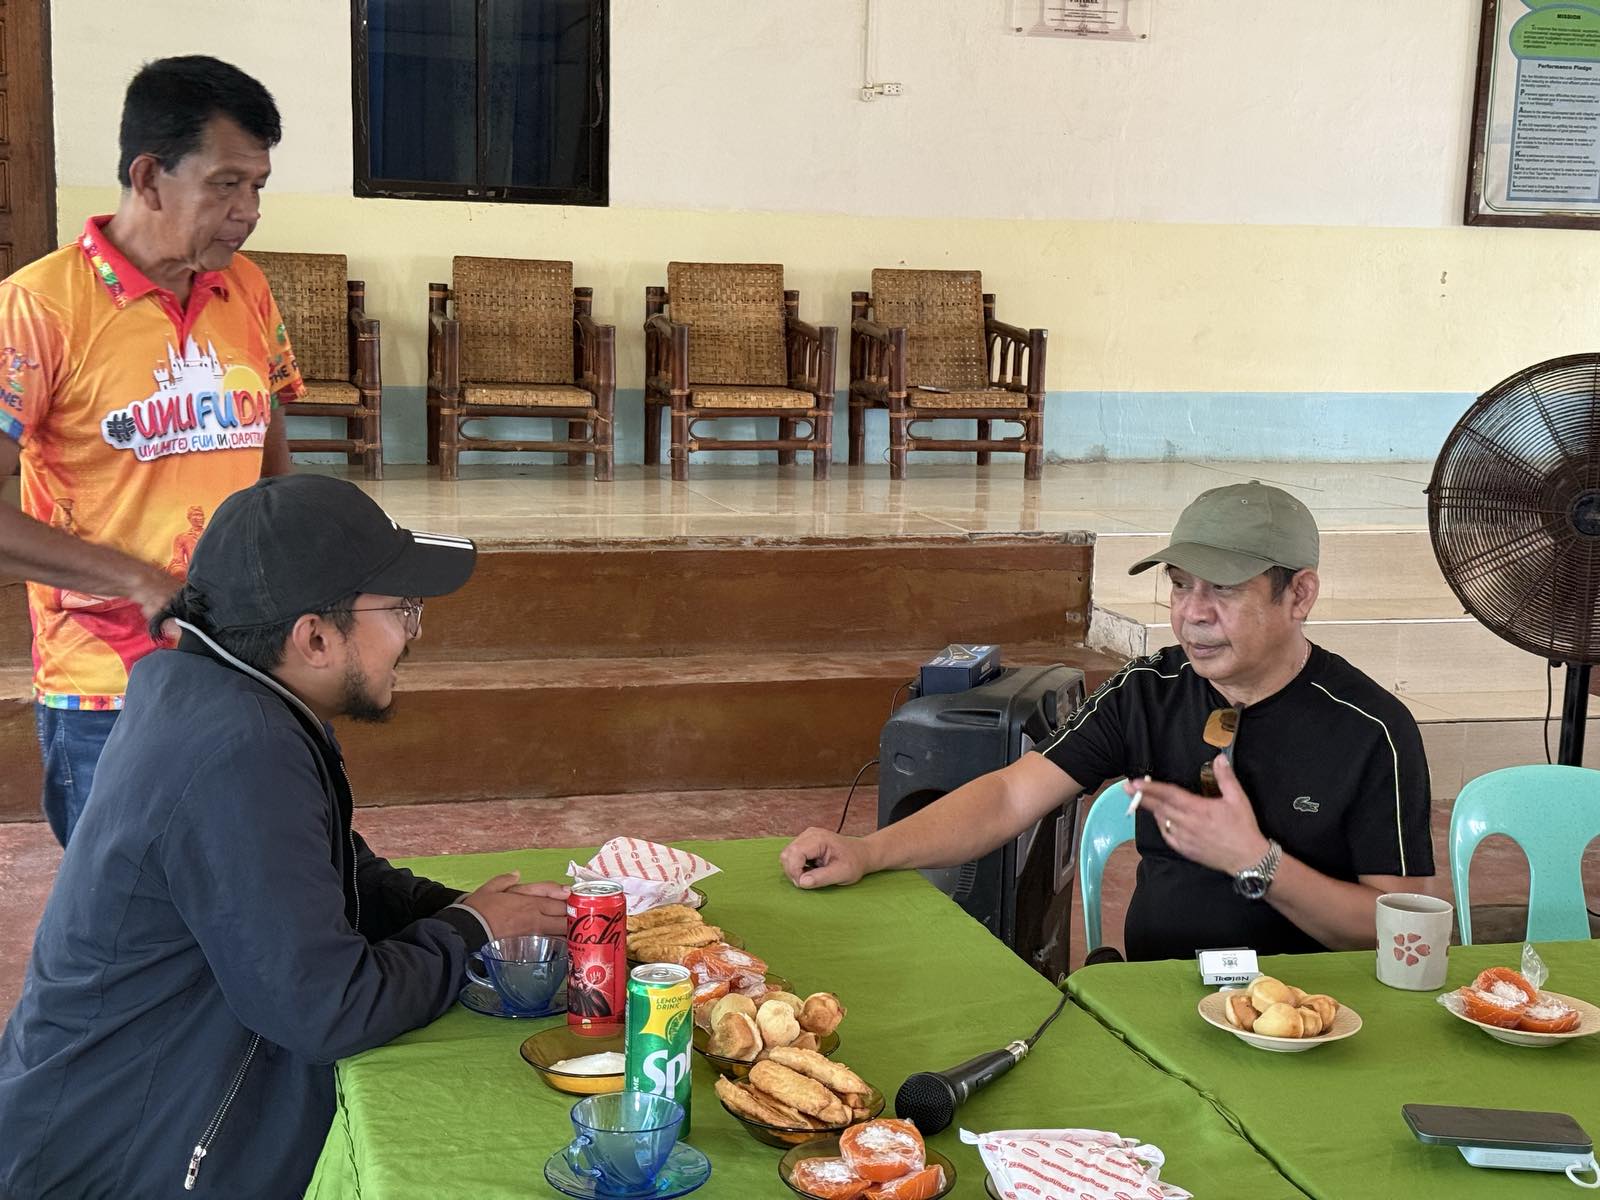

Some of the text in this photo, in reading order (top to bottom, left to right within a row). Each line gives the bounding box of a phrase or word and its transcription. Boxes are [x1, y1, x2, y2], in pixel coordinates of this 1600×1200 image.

[191, 434, 214, 449] FUN
[216, 433, 228, 447] IN
[656, 1002, 680, 1011] DRINK
